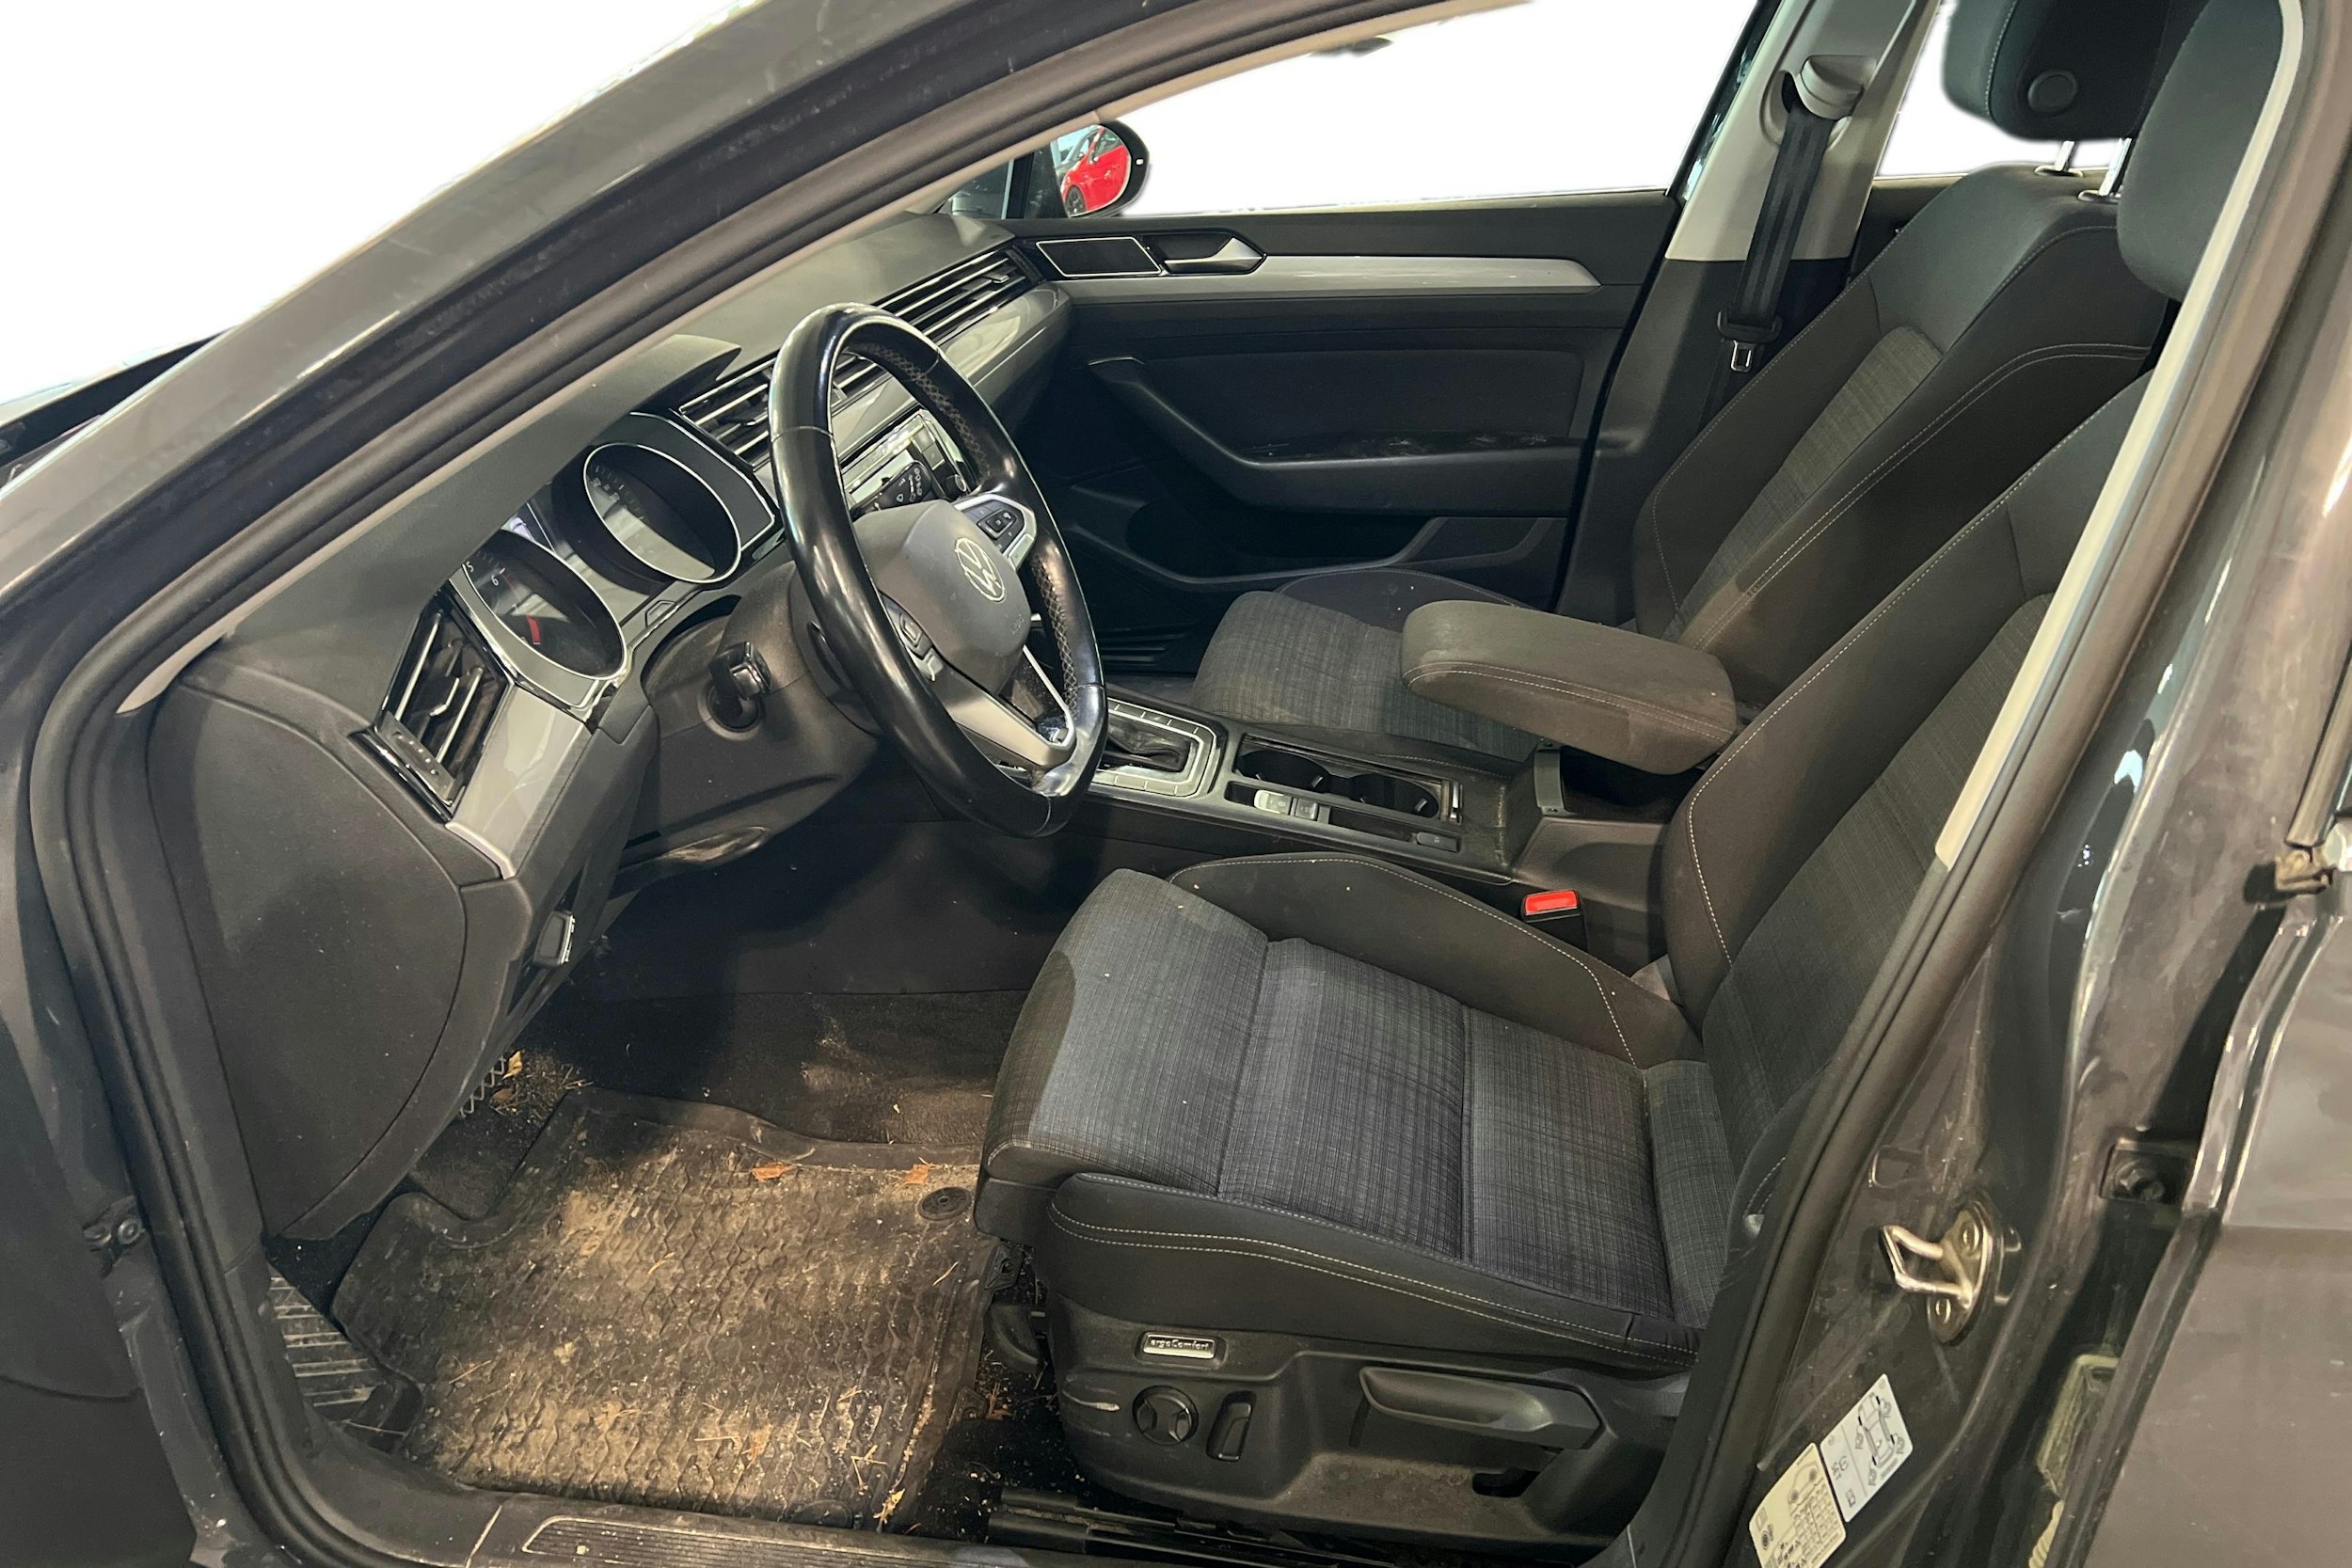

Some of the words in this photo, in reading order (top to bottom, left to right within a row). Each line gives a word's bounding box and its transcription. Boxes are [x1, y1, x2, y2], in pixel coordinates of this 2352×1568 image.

[466, 561, 474, 573] 5
[490, 574, 500, 586] 6
[1151, 1338, 1209, 1350] ergoComfort
